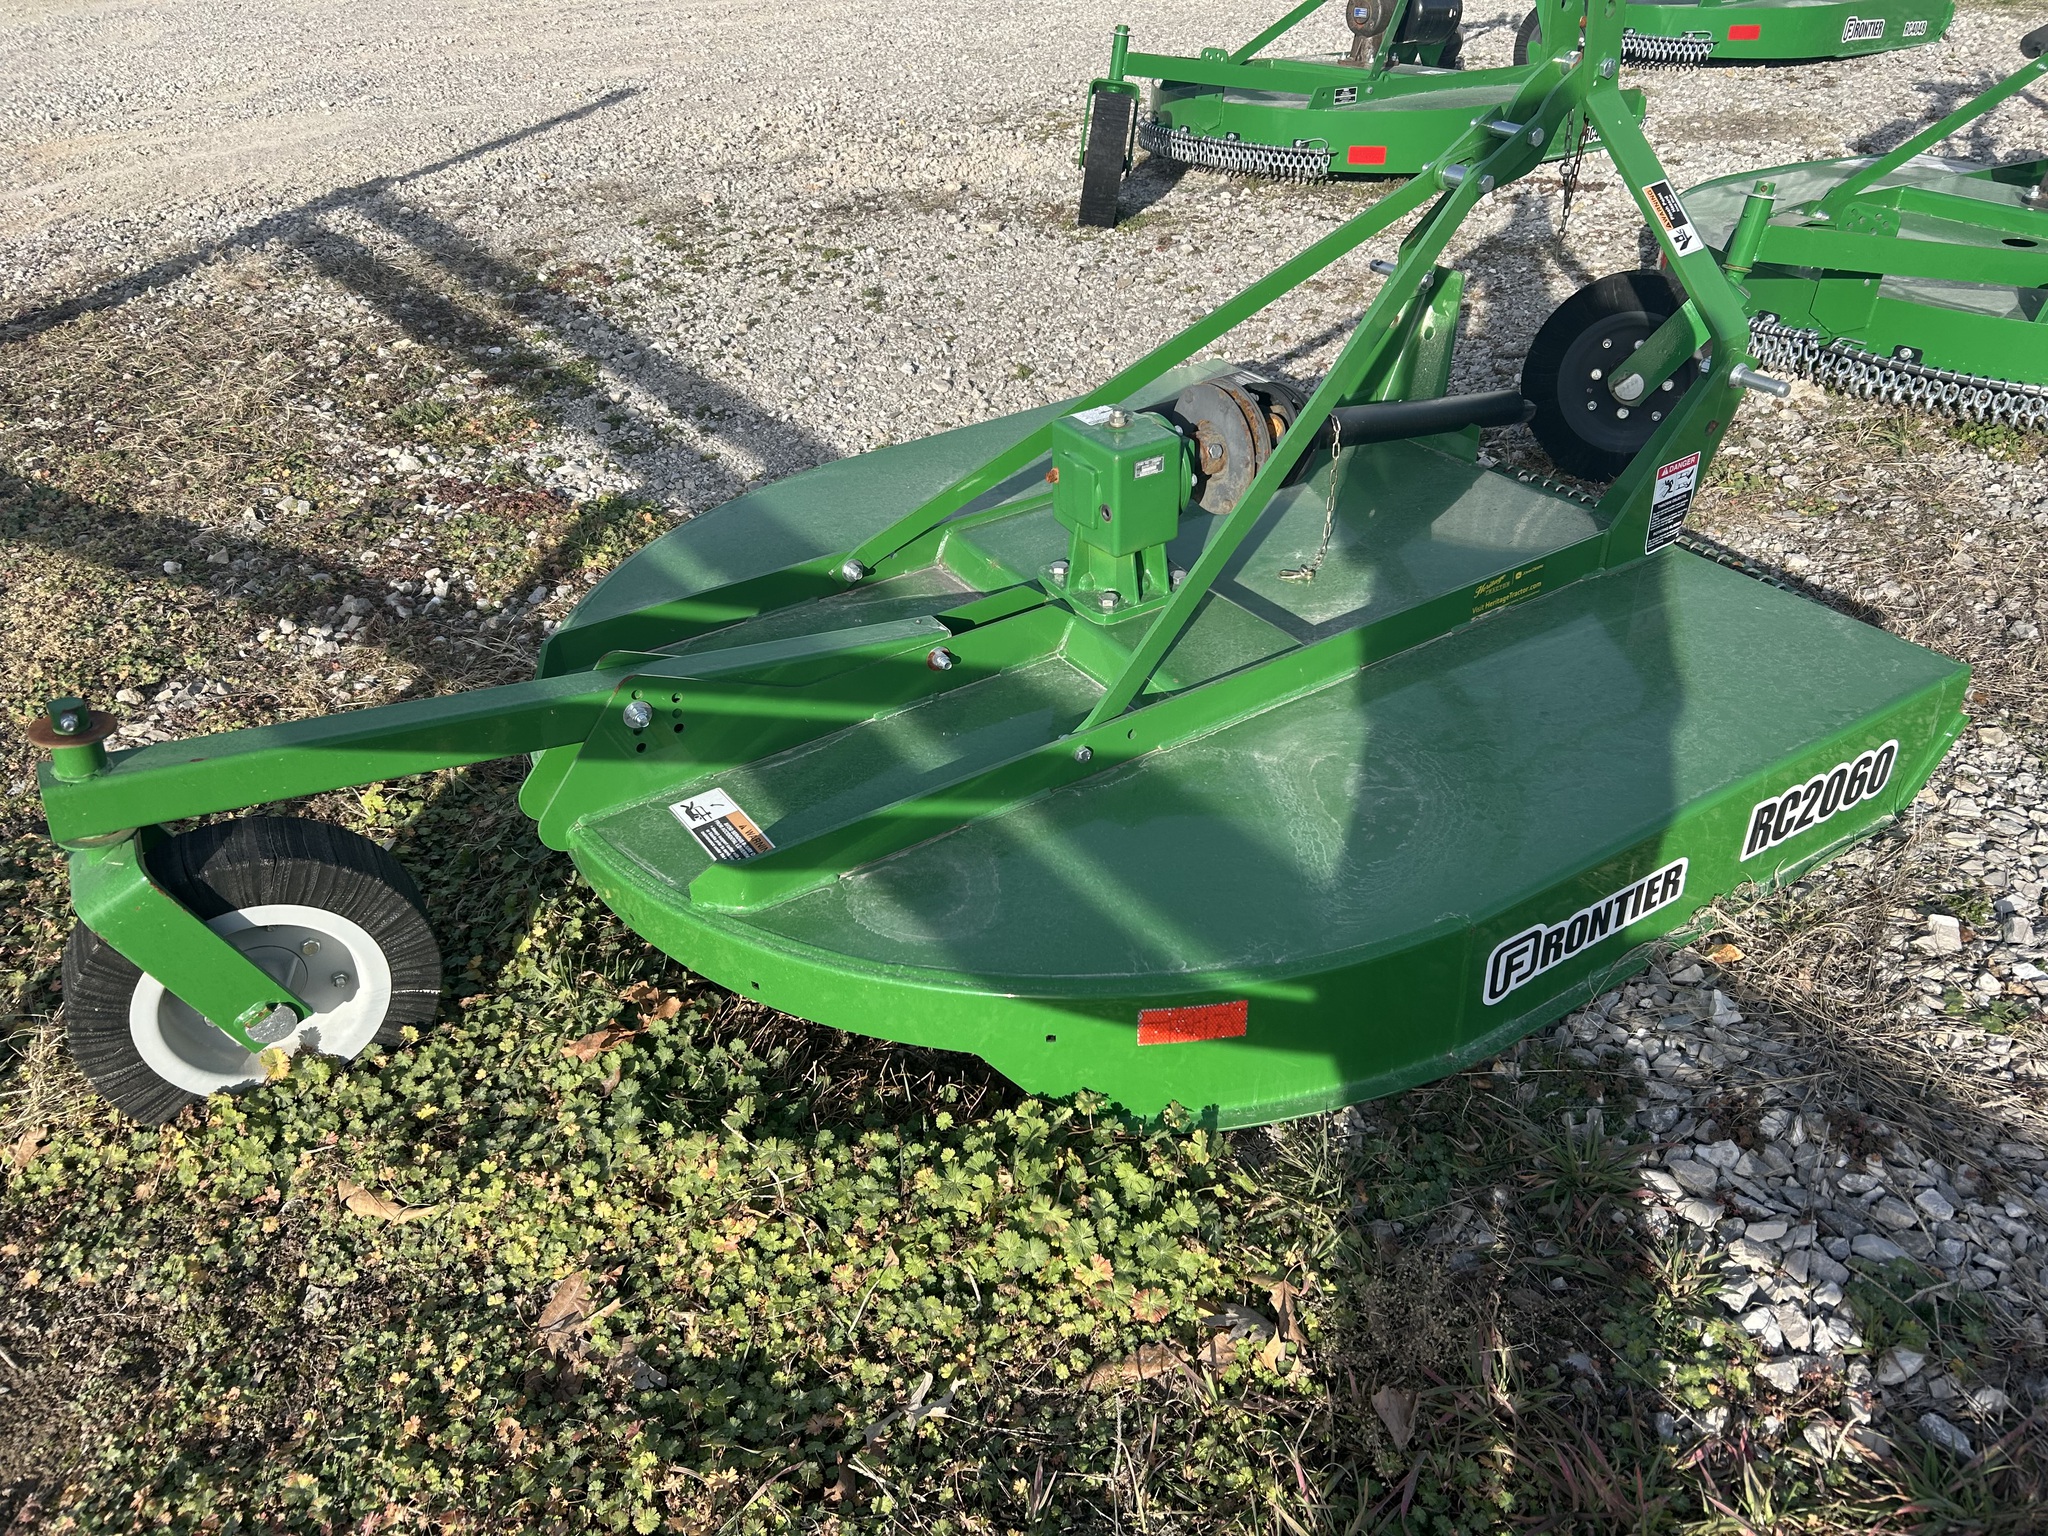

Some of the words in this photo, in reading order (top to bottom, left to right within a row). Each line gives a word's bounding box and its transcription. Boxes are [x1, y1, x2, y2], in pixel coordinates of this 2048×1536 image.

[1843, 18, 1884, 41] FRONTIER
[1647, 189, 1667, 223] WARNING
[1668, 456, 1697, 473] DANGER
[1472, 604, 1485, 614] Visit
[1485, 581, 1542, 608] HeritageTractor.com
[1745, 744, 1896, 856] RC2060
[745, 828, 769, 853] WARNIN
[1488, 863, 1684, 1000] FRONTIER
